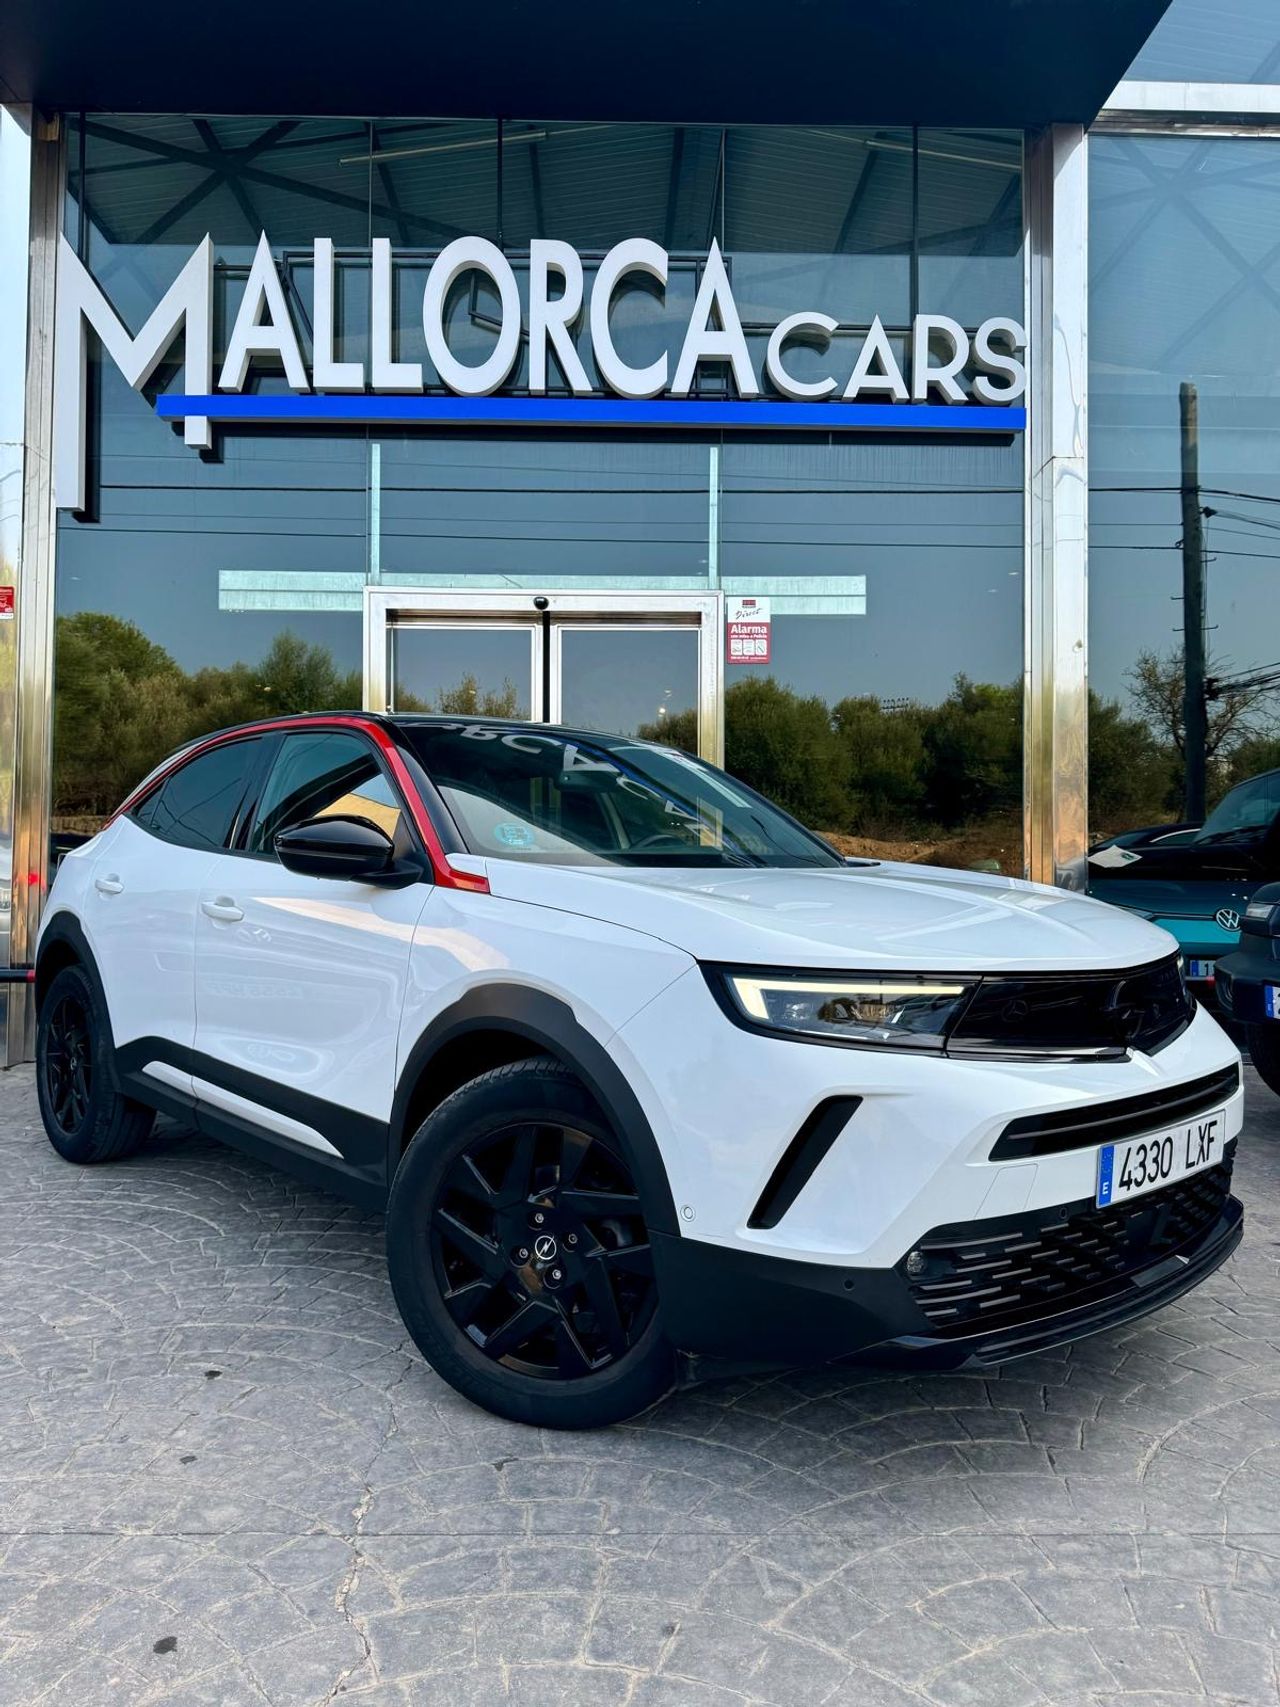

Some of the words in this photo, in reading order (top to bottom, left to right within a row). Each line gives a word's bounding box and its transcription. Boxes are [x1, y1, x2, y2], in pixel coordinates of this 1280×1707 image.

[53, 230, 760, 514] MALLORCA
[766, 312, 1027, 406] CARS
[731, 624, 768, 634] Alarma
[1102, 1181, 1110, 1195] E
[1119, 1136, 1174, 1191] 4330
[1185, 1120, 1218, 1169] LXF
